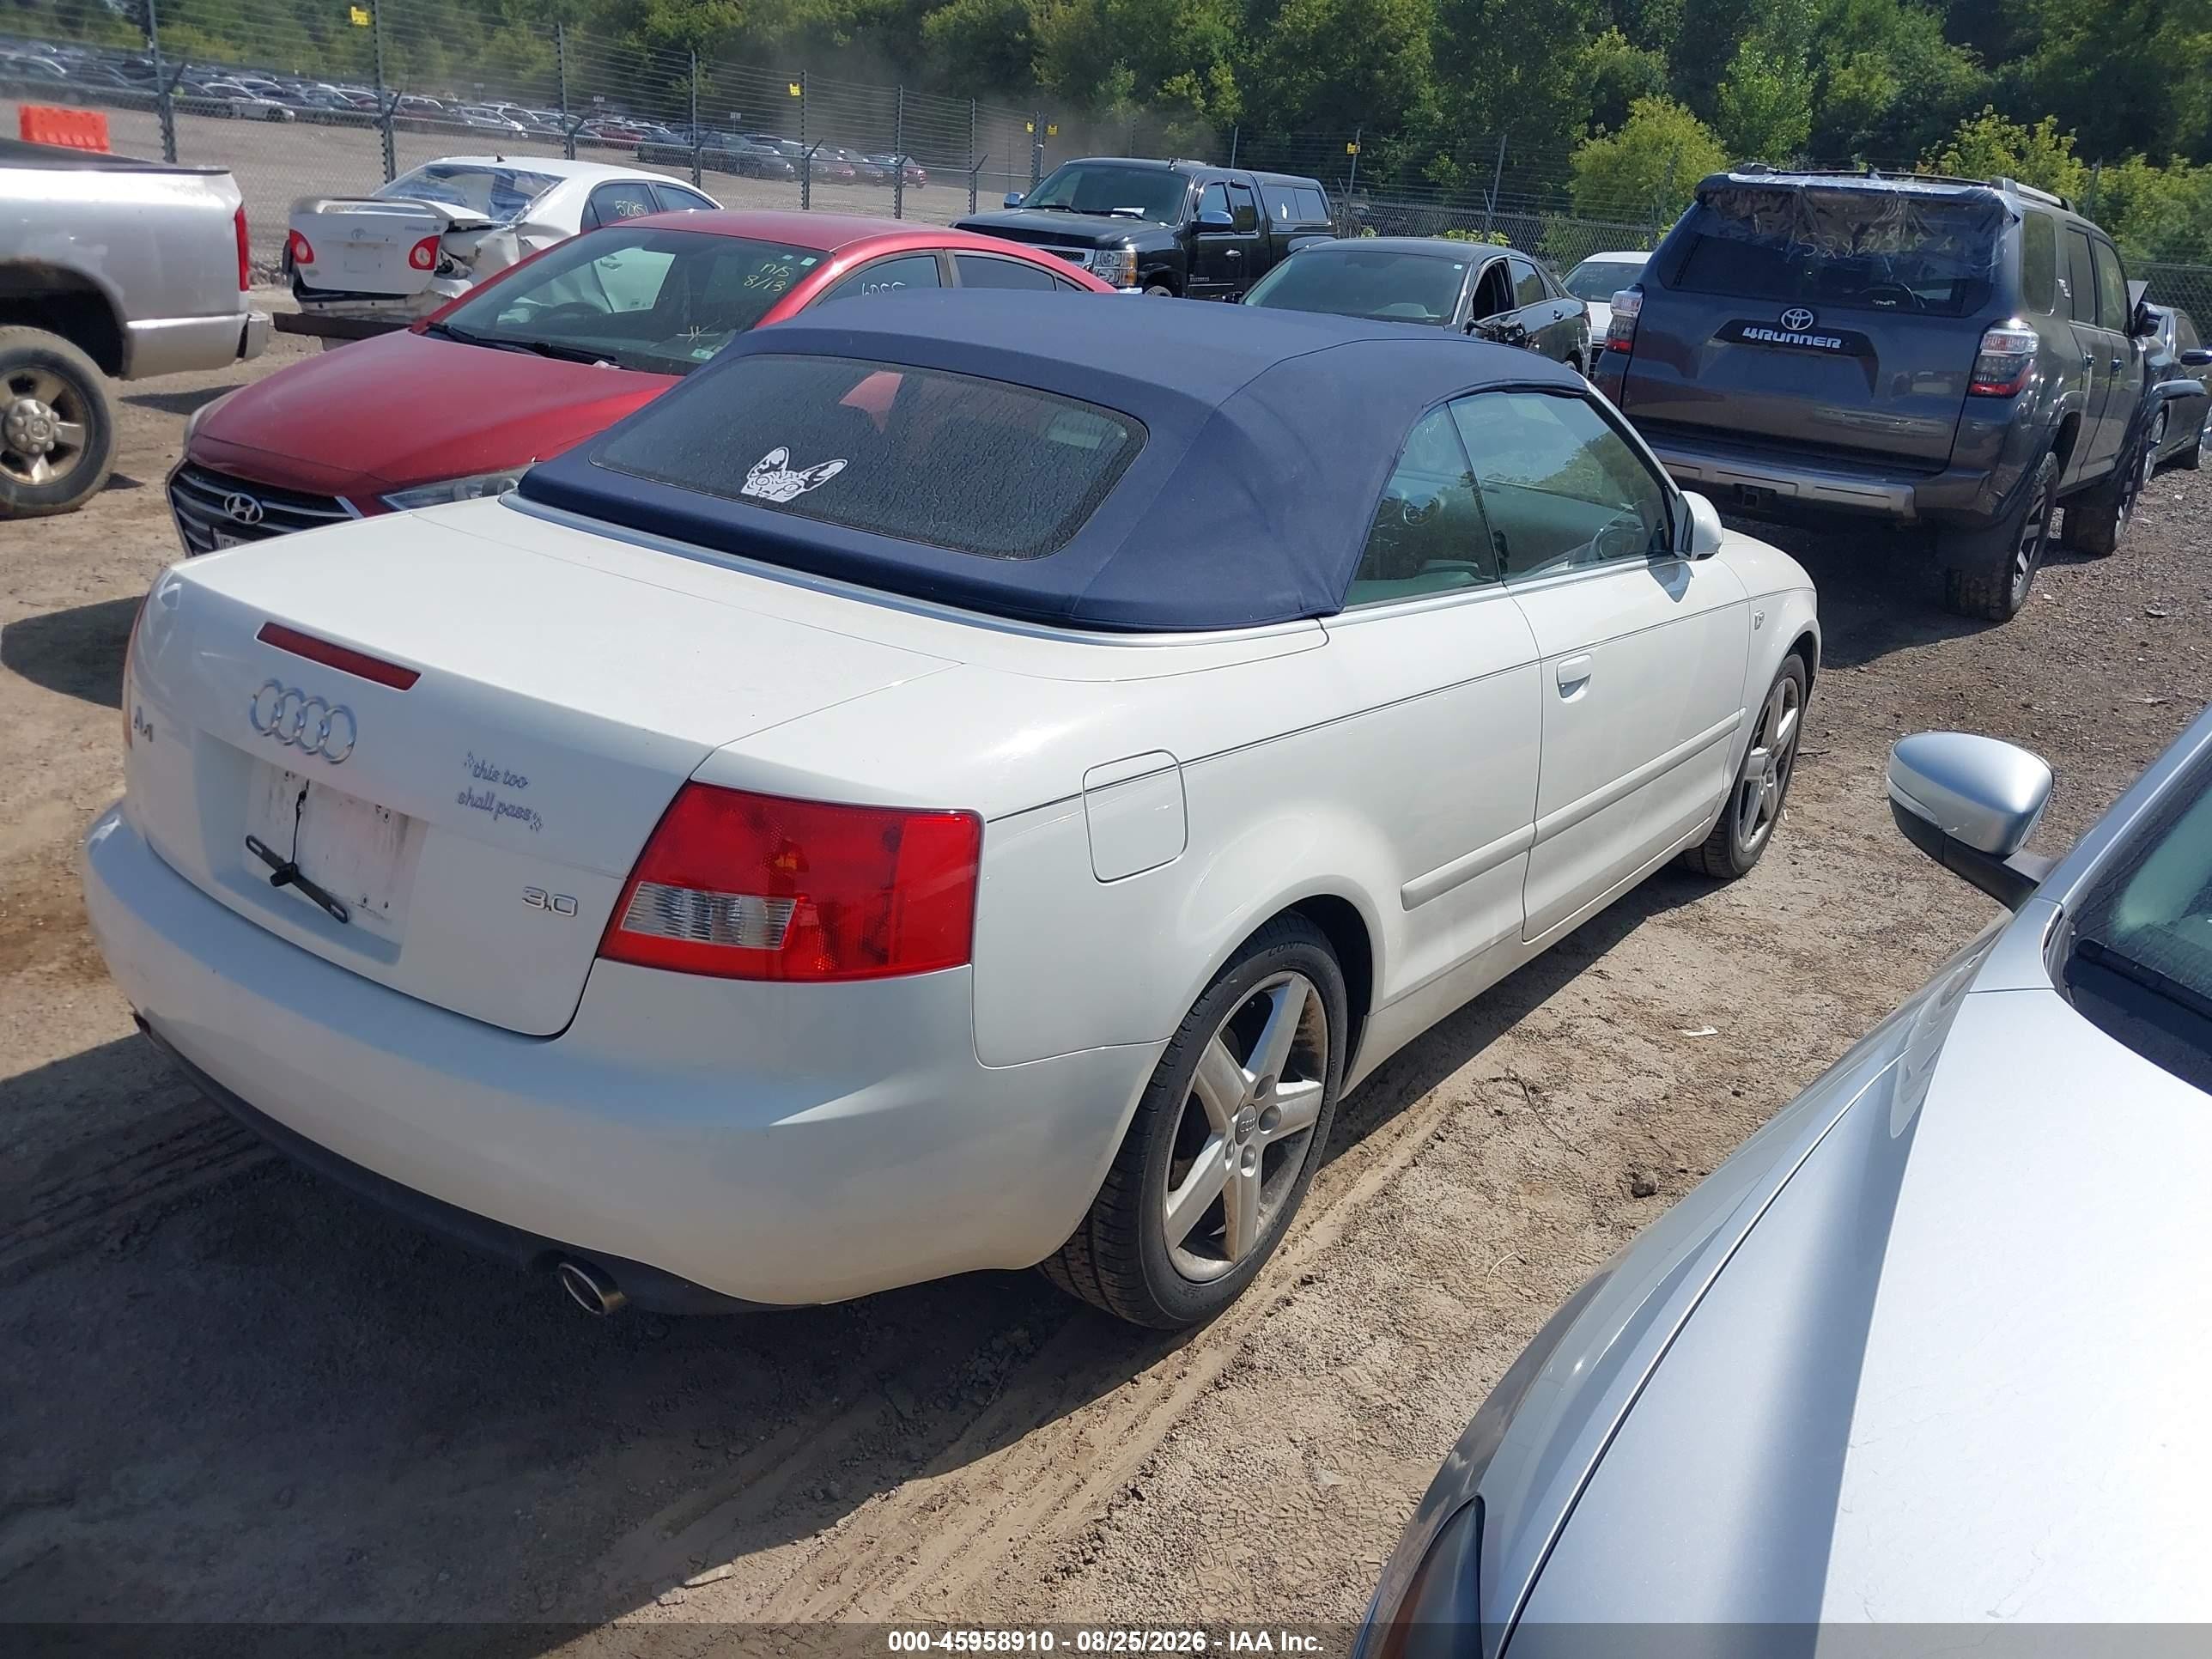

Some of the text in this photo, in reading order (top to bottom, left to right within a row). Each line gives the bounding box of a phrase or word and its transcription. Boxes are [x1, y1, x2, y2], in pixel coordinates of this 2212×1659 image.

[744, 274, 787, 292] 8/13
[1742, 327, 1842, 349] 4RUNNER
[472, 759, 529, 789] this too
[458, 786, 532, 821] shall pass
[522, 886, 579, 917] 3.0
